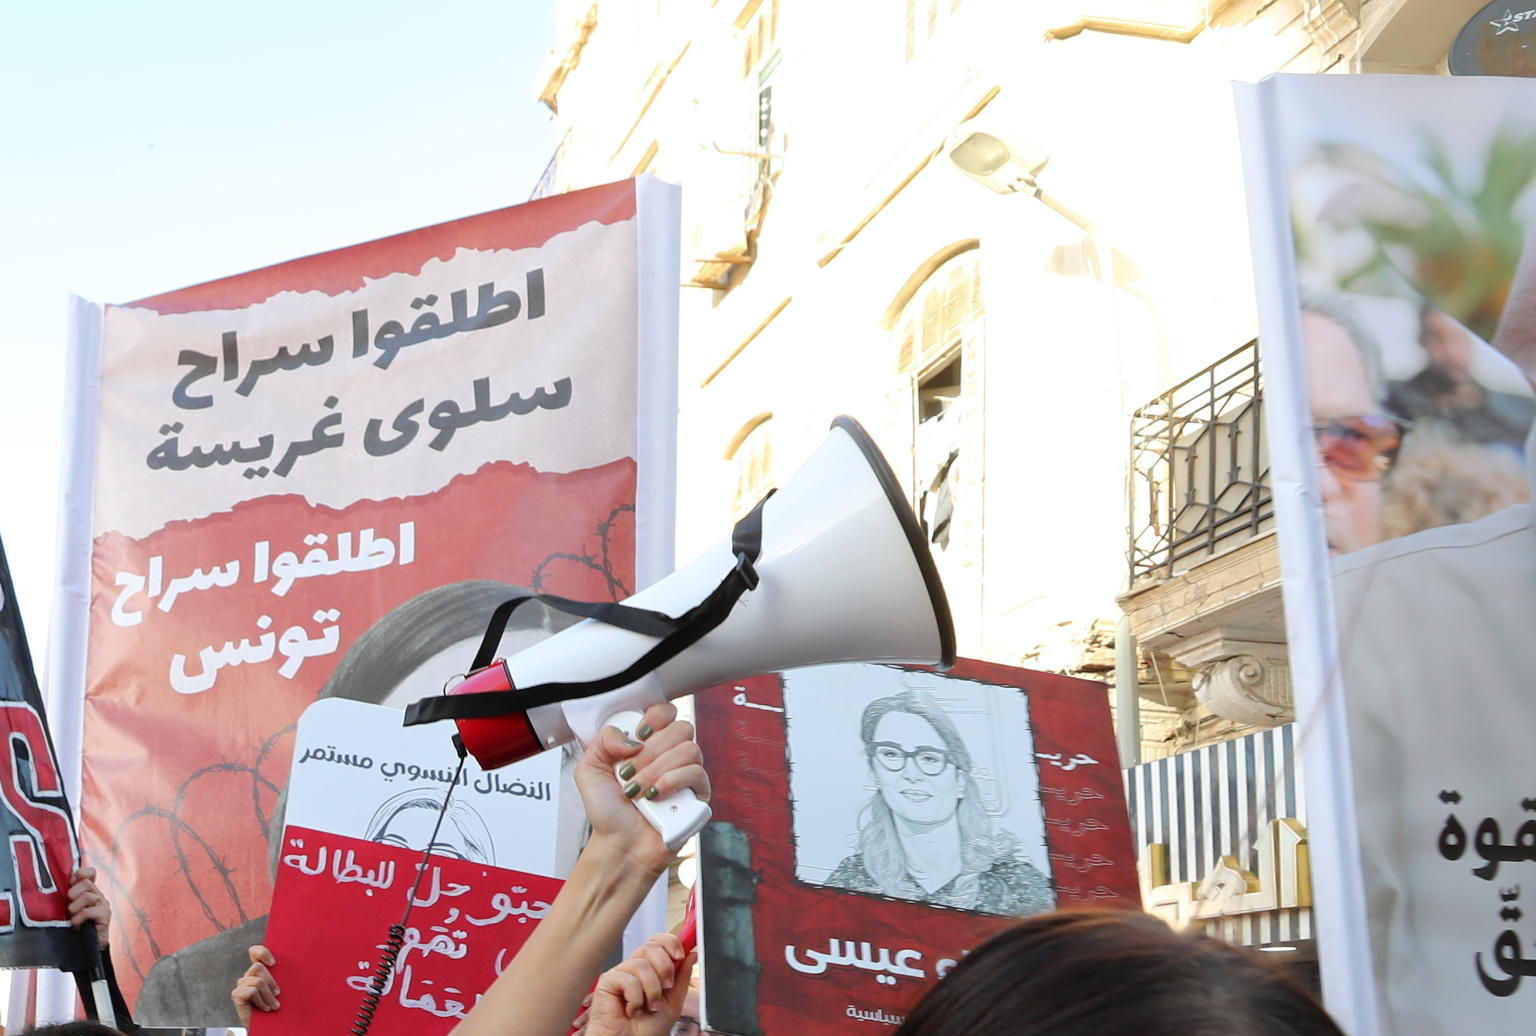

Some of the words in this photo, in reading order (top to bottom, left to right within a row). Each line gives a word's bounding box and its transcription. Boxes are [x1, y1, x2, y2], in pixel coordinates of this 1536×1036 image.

[351, 267, 547, 371] اطلقوا
[171, 331, 335, 410] سراح
[145, 395, 345, 480] غريسة
[364, 376, 573, 457] سلوى
[110, 555, 240, 627] سراح
[253, 521, 416, 597] اطلقوا
[169, 607, 341, 694] تونس
[299, 745, 374, 770] مستمر
[380, 760, 468, 787] النسوي
[474, 772, 552, 801] النضال
[283, 838, 396, 897] للبطالة
[784, 938, 926, 985] عيسى
